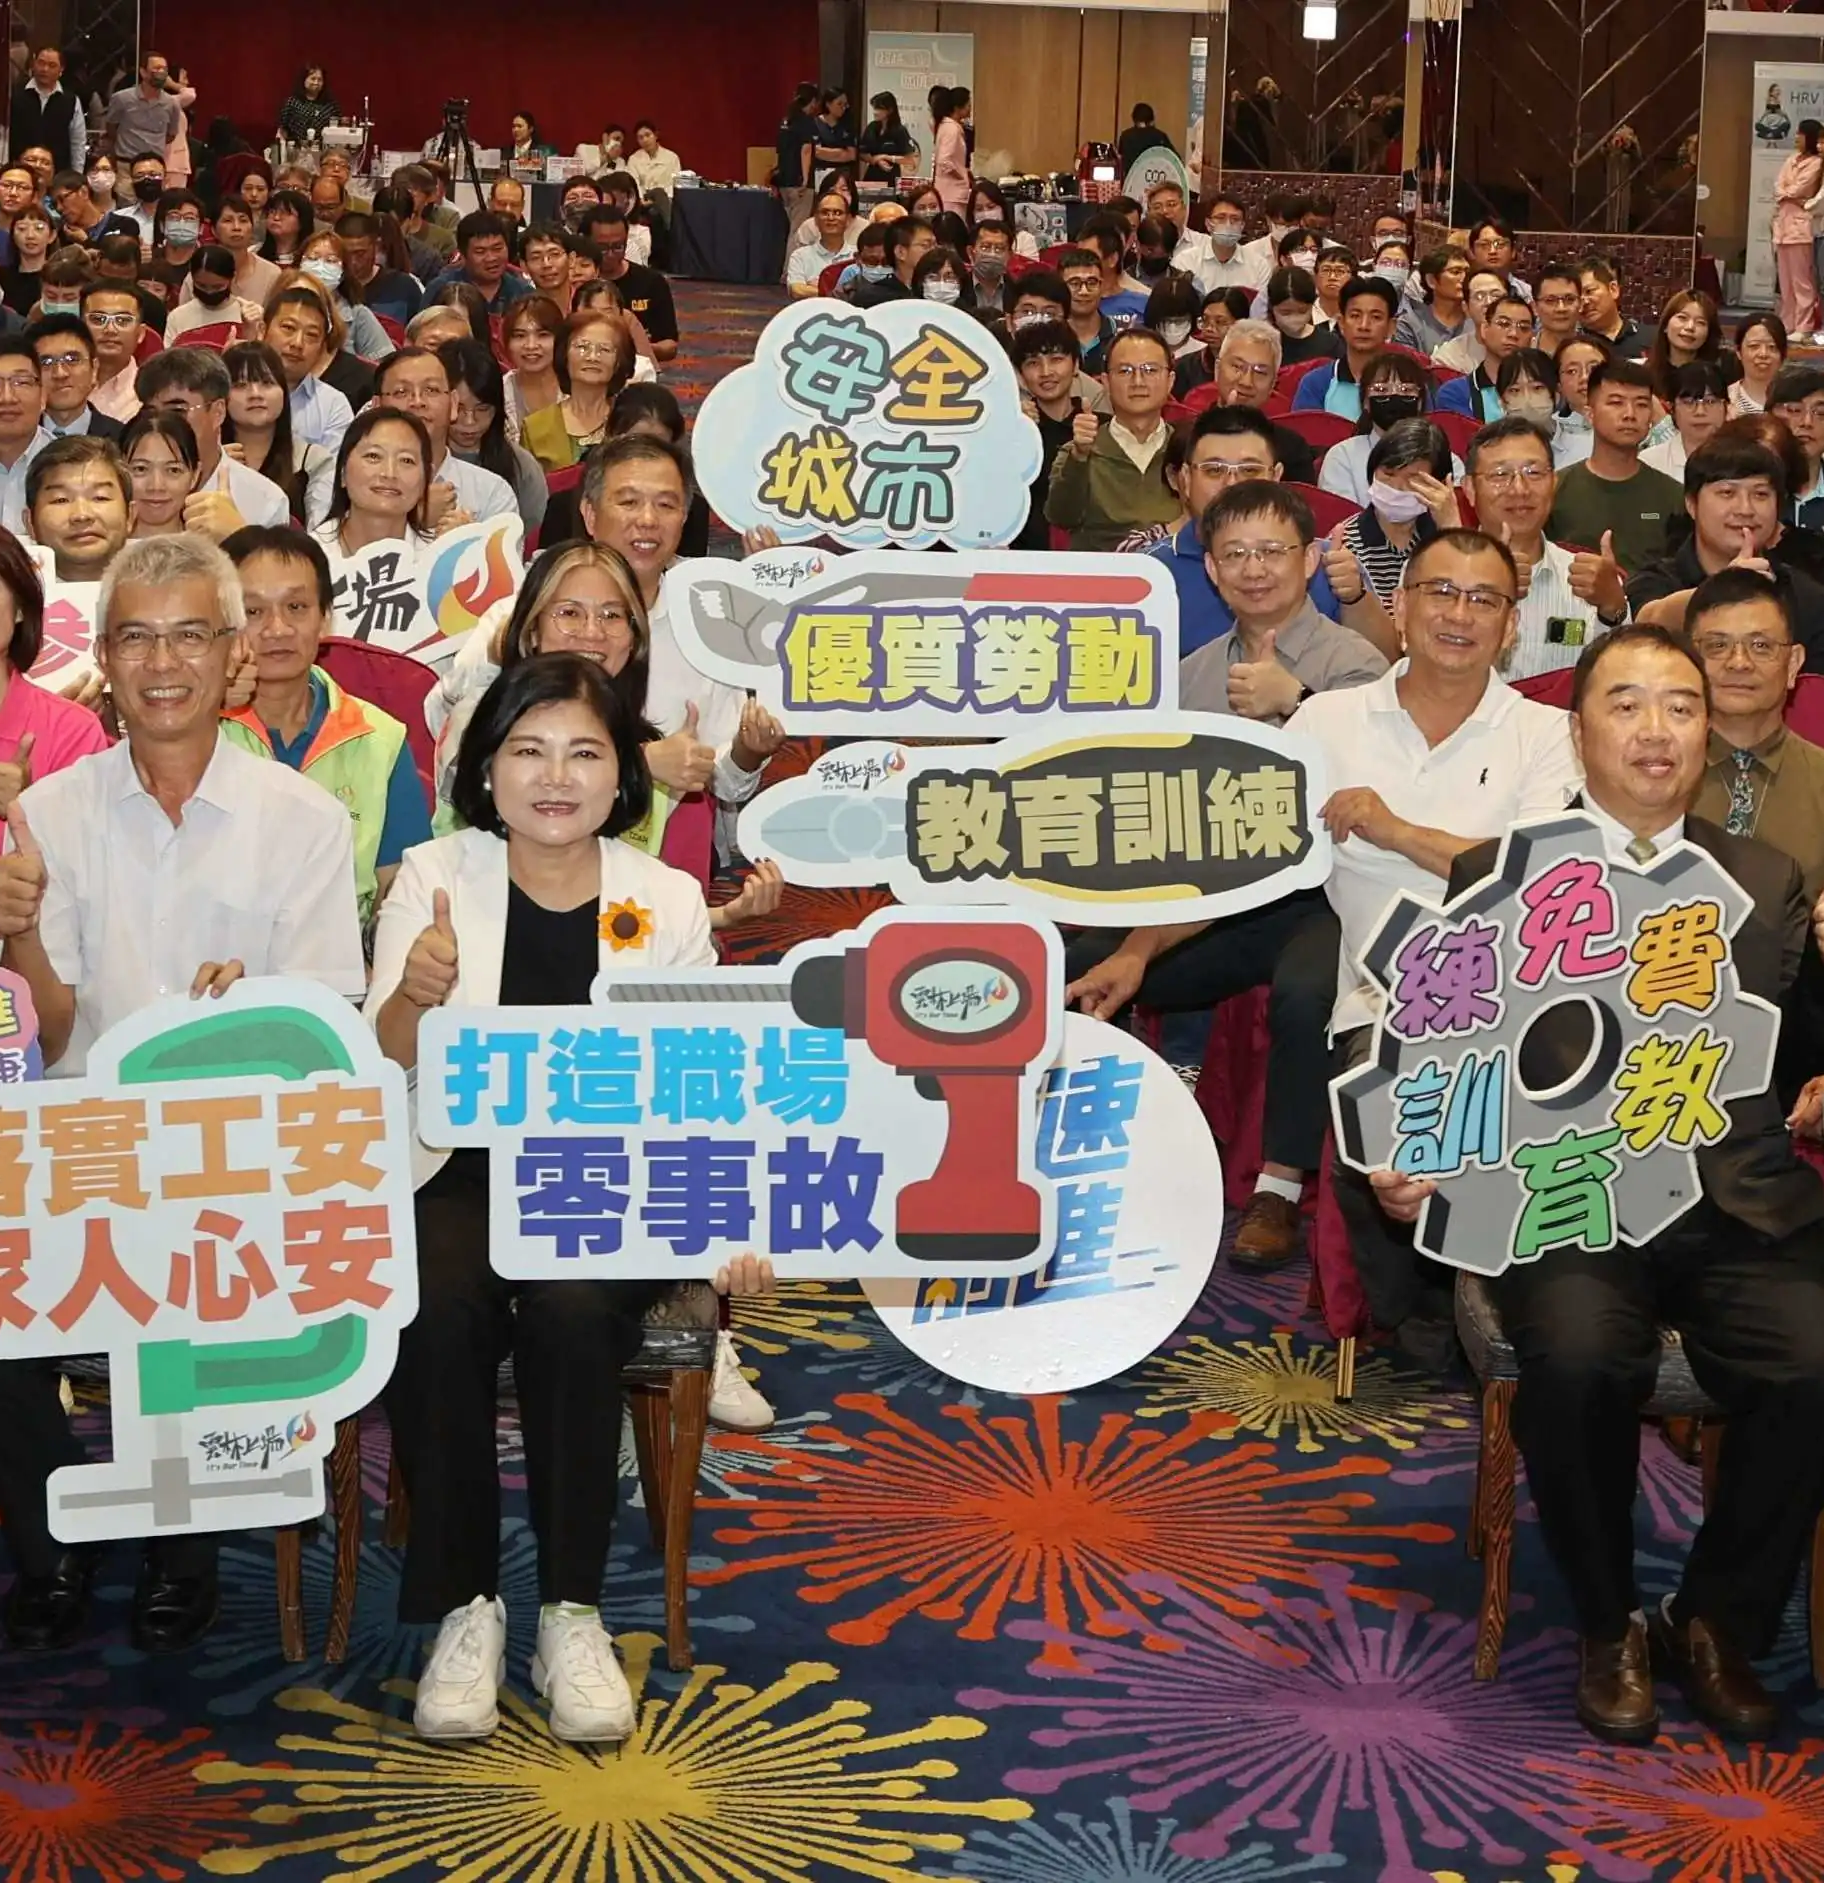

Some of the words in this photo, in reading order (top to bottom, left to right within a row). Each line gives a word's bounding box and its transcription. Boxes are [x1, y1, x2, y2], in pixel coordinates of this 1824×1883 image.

[1790, 91, 1820, 105] HRV
[631, 299, 650, 311] CAT
[784, 315, 987, 424] 安全
[760, 426, 958, 528] 城市
[783, 611, 1155, 707] 優質勞動
[915, 765, 1303, 873] 教育訓練
[444, 1027, 851, 1127] 打造職場
[515, 1135, 885, 1259] 零事故
